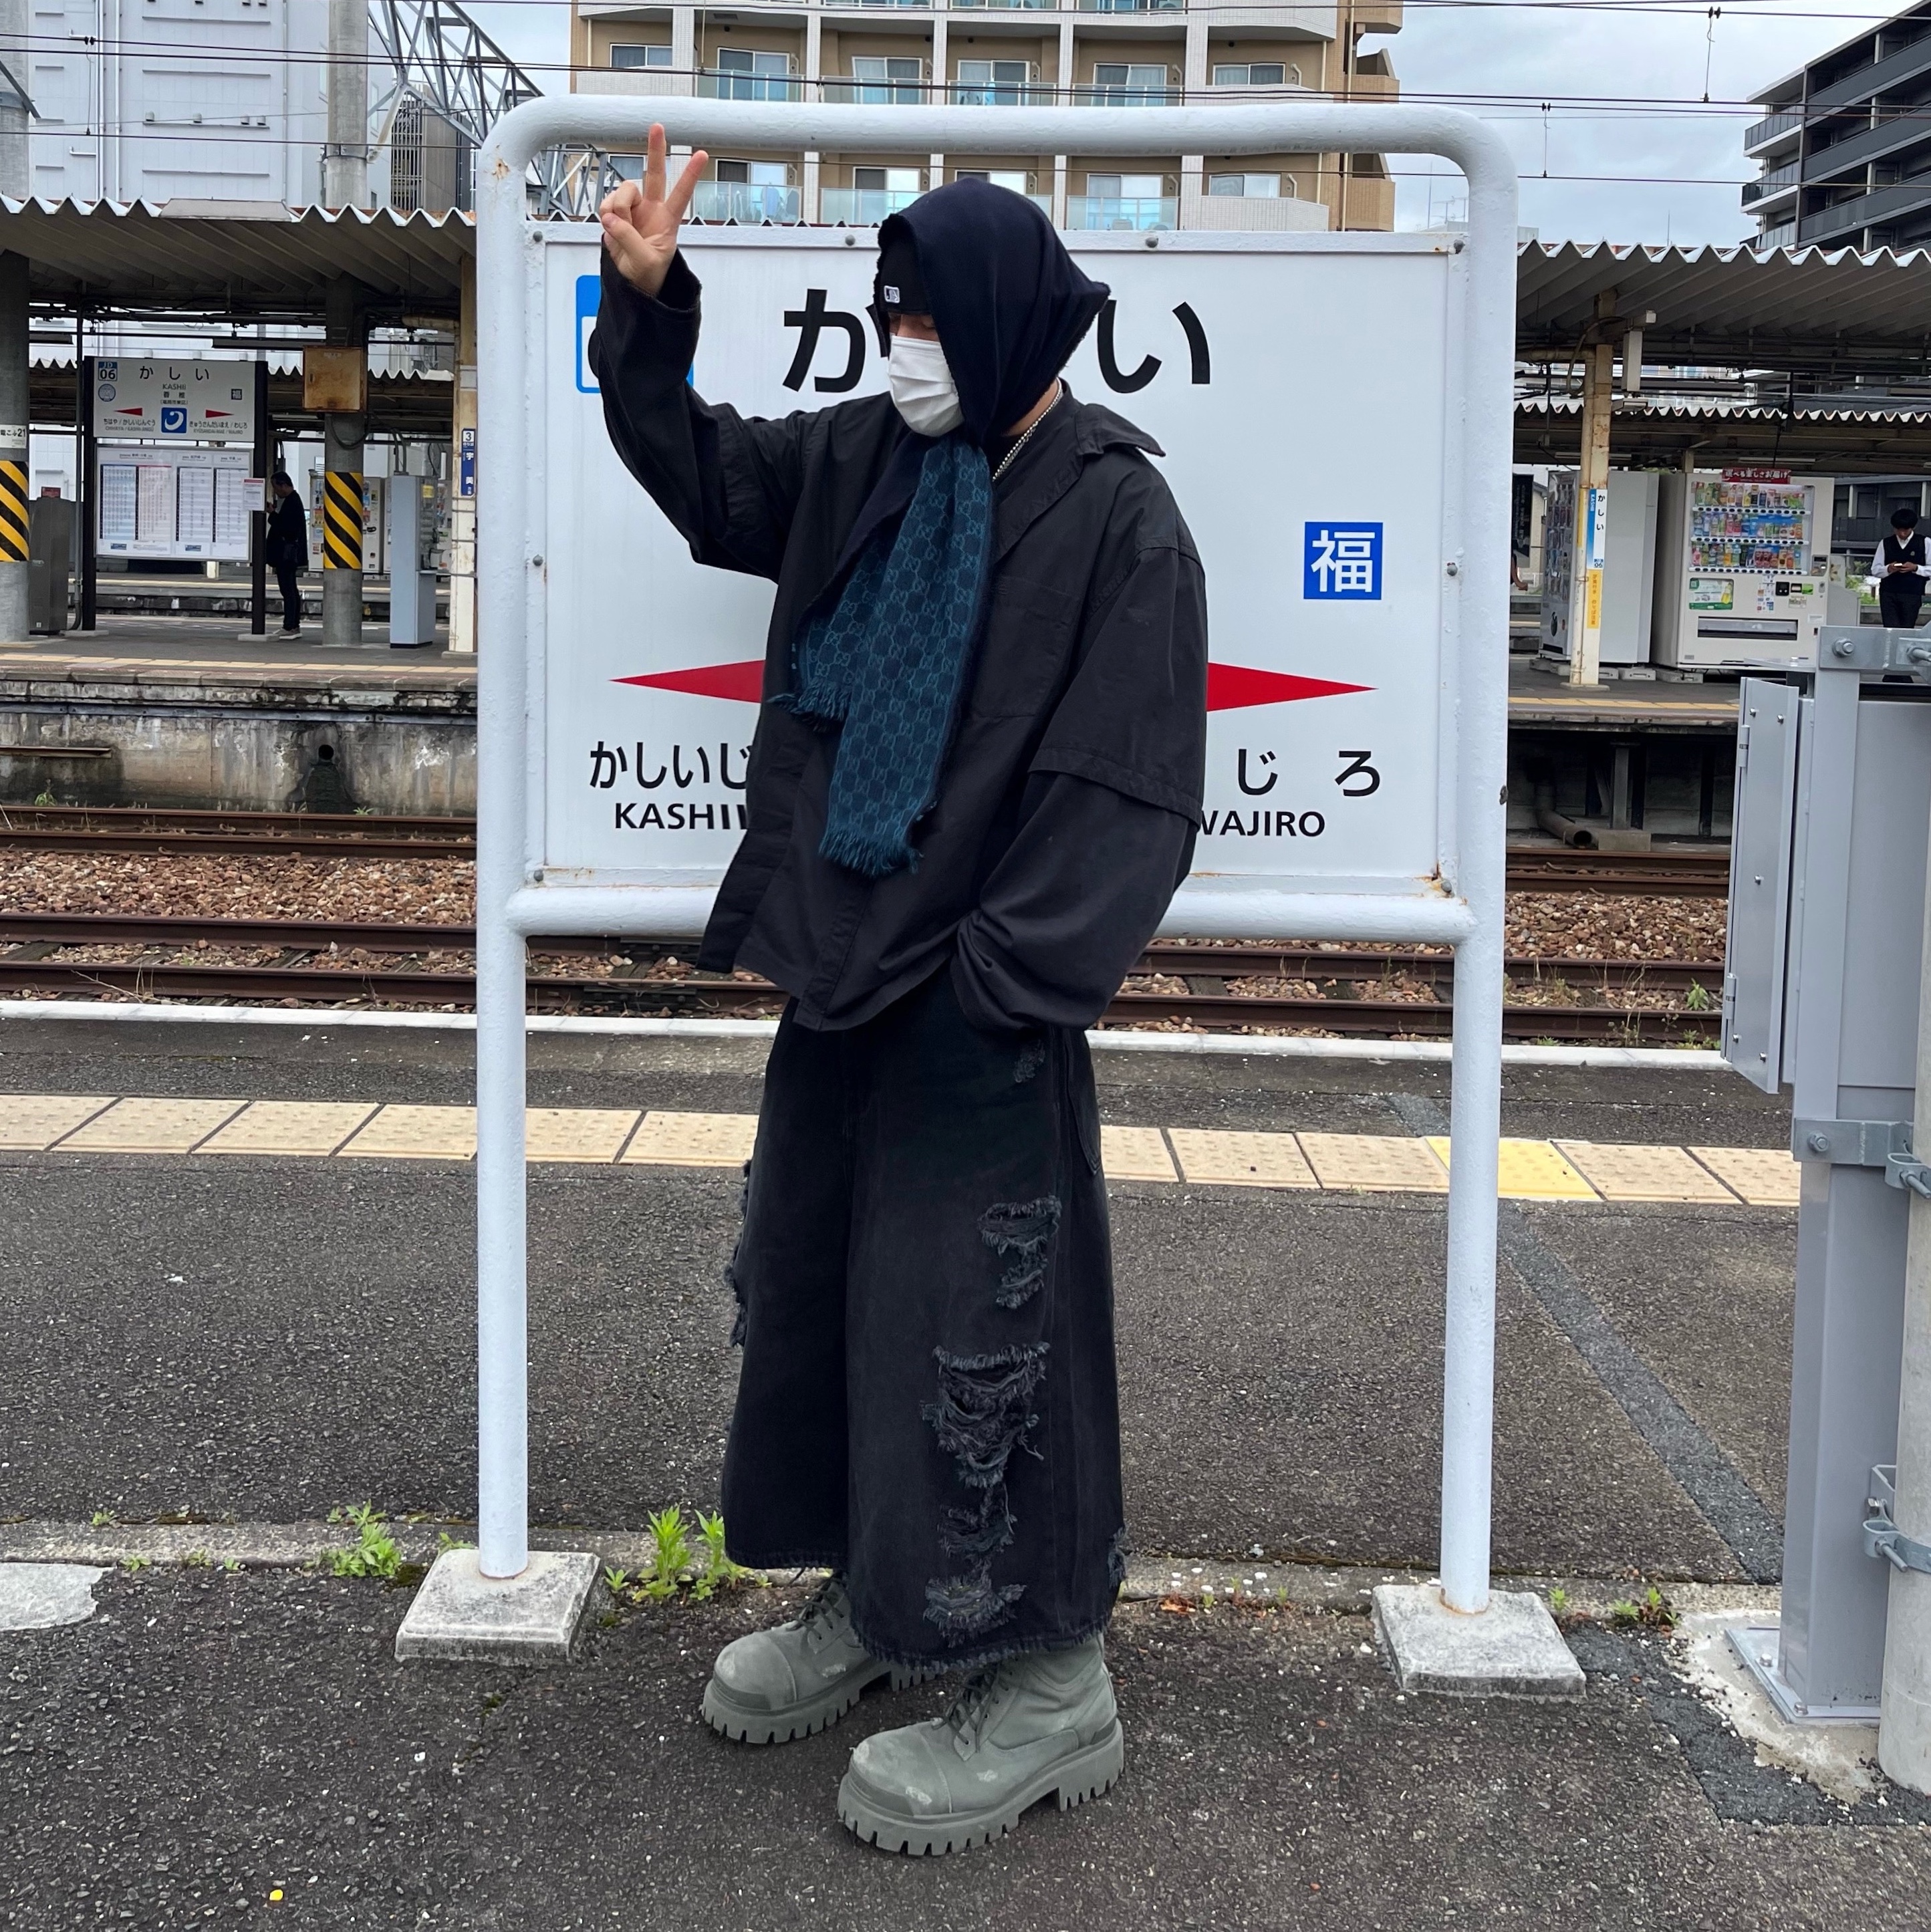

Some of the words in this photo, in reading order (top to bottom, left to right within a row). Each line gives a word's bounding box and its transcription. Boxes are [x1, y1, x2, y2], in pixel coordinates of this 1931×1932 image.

[100, 369, 116, 380] 06
[139, 365, 209, 381] かしい
[465, 432, 472, 441] 3
[1596, 495, 1605, 531] かしい
[1310, 529, 1376, 593] 福
